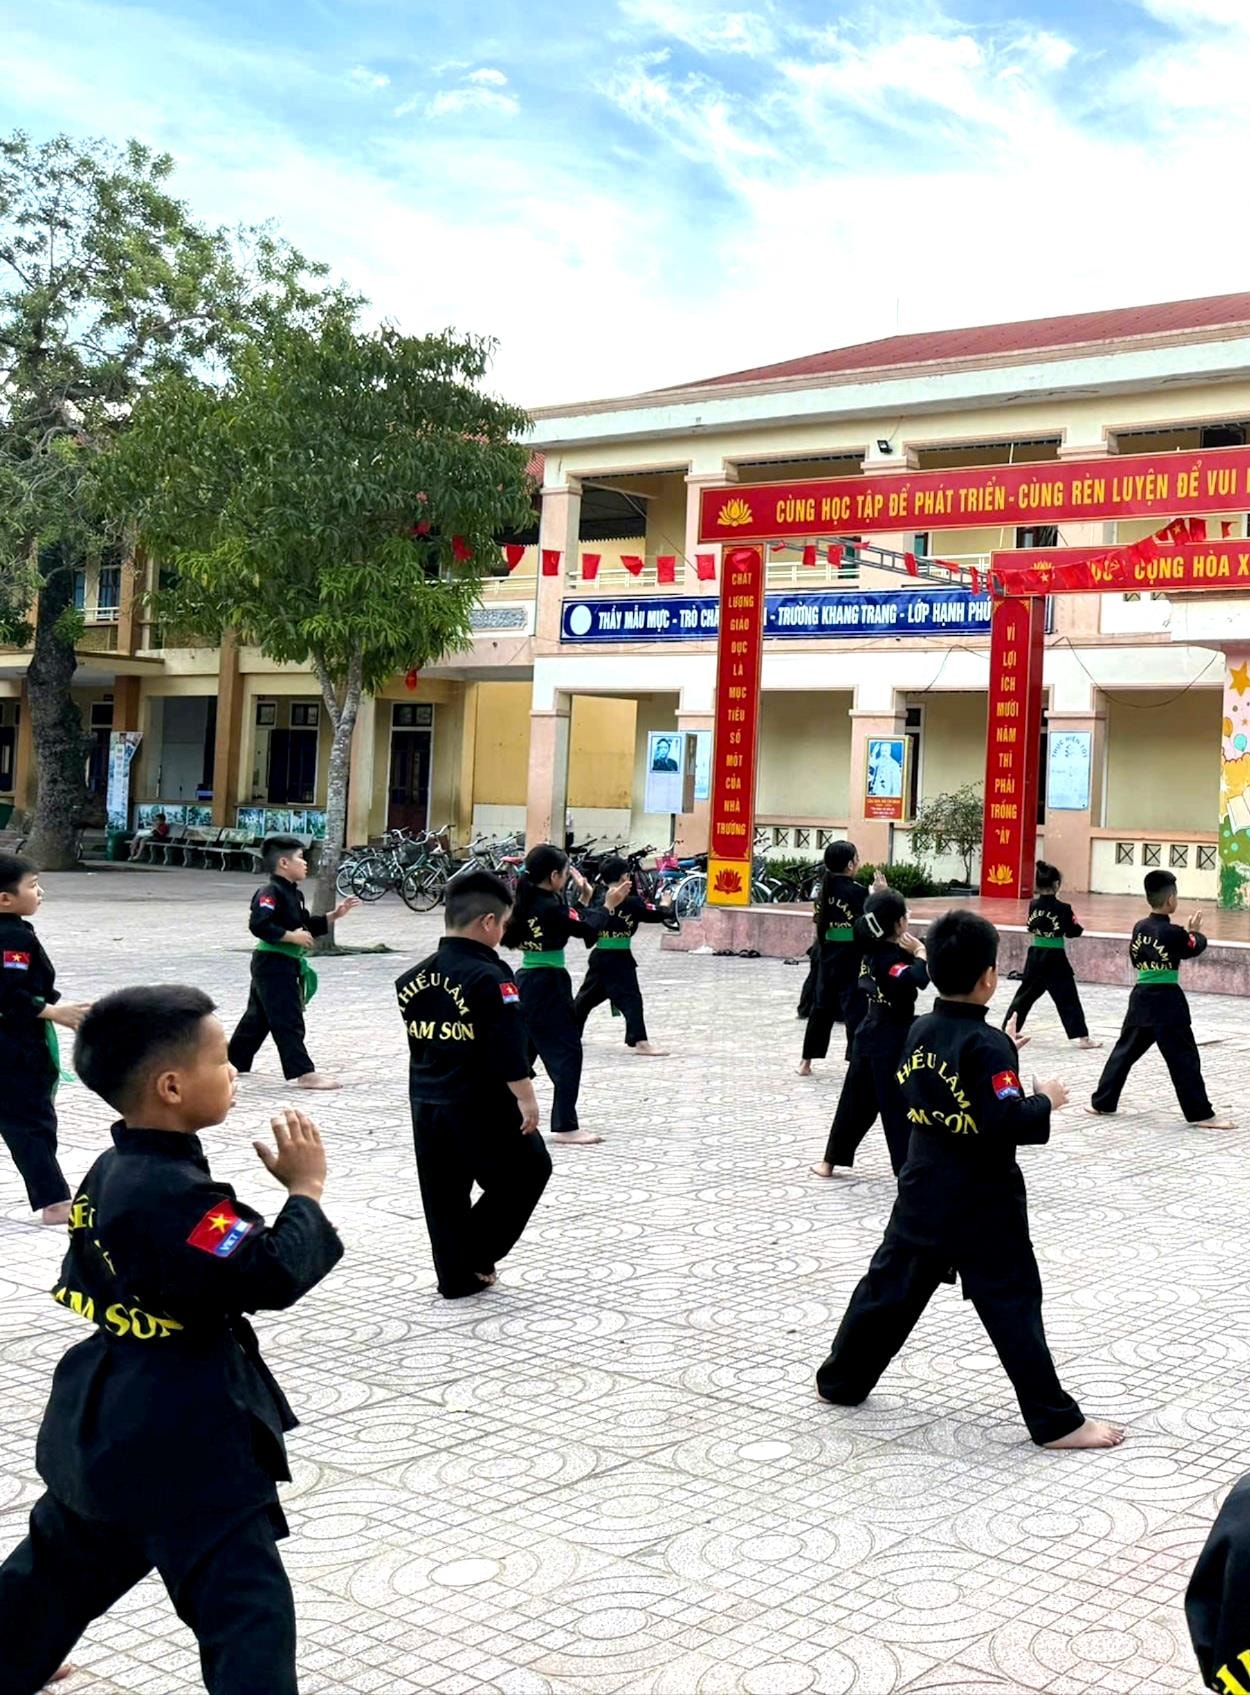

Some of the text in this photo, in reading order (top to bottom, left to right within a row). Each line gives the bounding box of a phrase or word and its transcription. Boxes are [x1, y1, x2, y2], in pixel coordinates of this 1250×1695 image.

[776, 494, 815, 523] CÙNG
[821, 496, 850, 525] HỌC
[856, 490, 882, 524] TẬP
[888, 482, 911, 517] ĐỂ
[914, 483, 954, 515] PHÁT
[959, 476, 1005, 512] TRIỂN
[1018, 476, 1063, 509] CÙNG
[1072, 472, 1105, 505] RÈN
[1112, 468, 1169, 506] LUYỆN
[1177, 459, 1203, 498] ĐỂ
[1207, 468, 1236, 496] VUI
[1192, 550, 1230, 578] HÒA
[647, 609, 670, 632] MỰC
[680, 605, 698, 628] TRÒ
[778, 602, 819, 625] TRƯỜNG
[821, 605, 859, 625] KHANG
[861, 604, 897, 624] TRANG
[908, 599, 929, 623] LỚP
[932, 602, 965, 626] HẠNH
[968, 595, 991, 621] PHÚ
[1007, 622, 1016, 641] VÌ
[1003, 650, 1017, 669] LỢI
[1001, 674, 1016, 692] ÍCH
[728, 687, 747, 702] MỤC
[725, 773, 741, 789] CỦA
[994, 774, 1015, 793] PHẢI
[724, 797, 740, 812] NHÀ
[716, 819, 746, 836] TRƯỜNG
